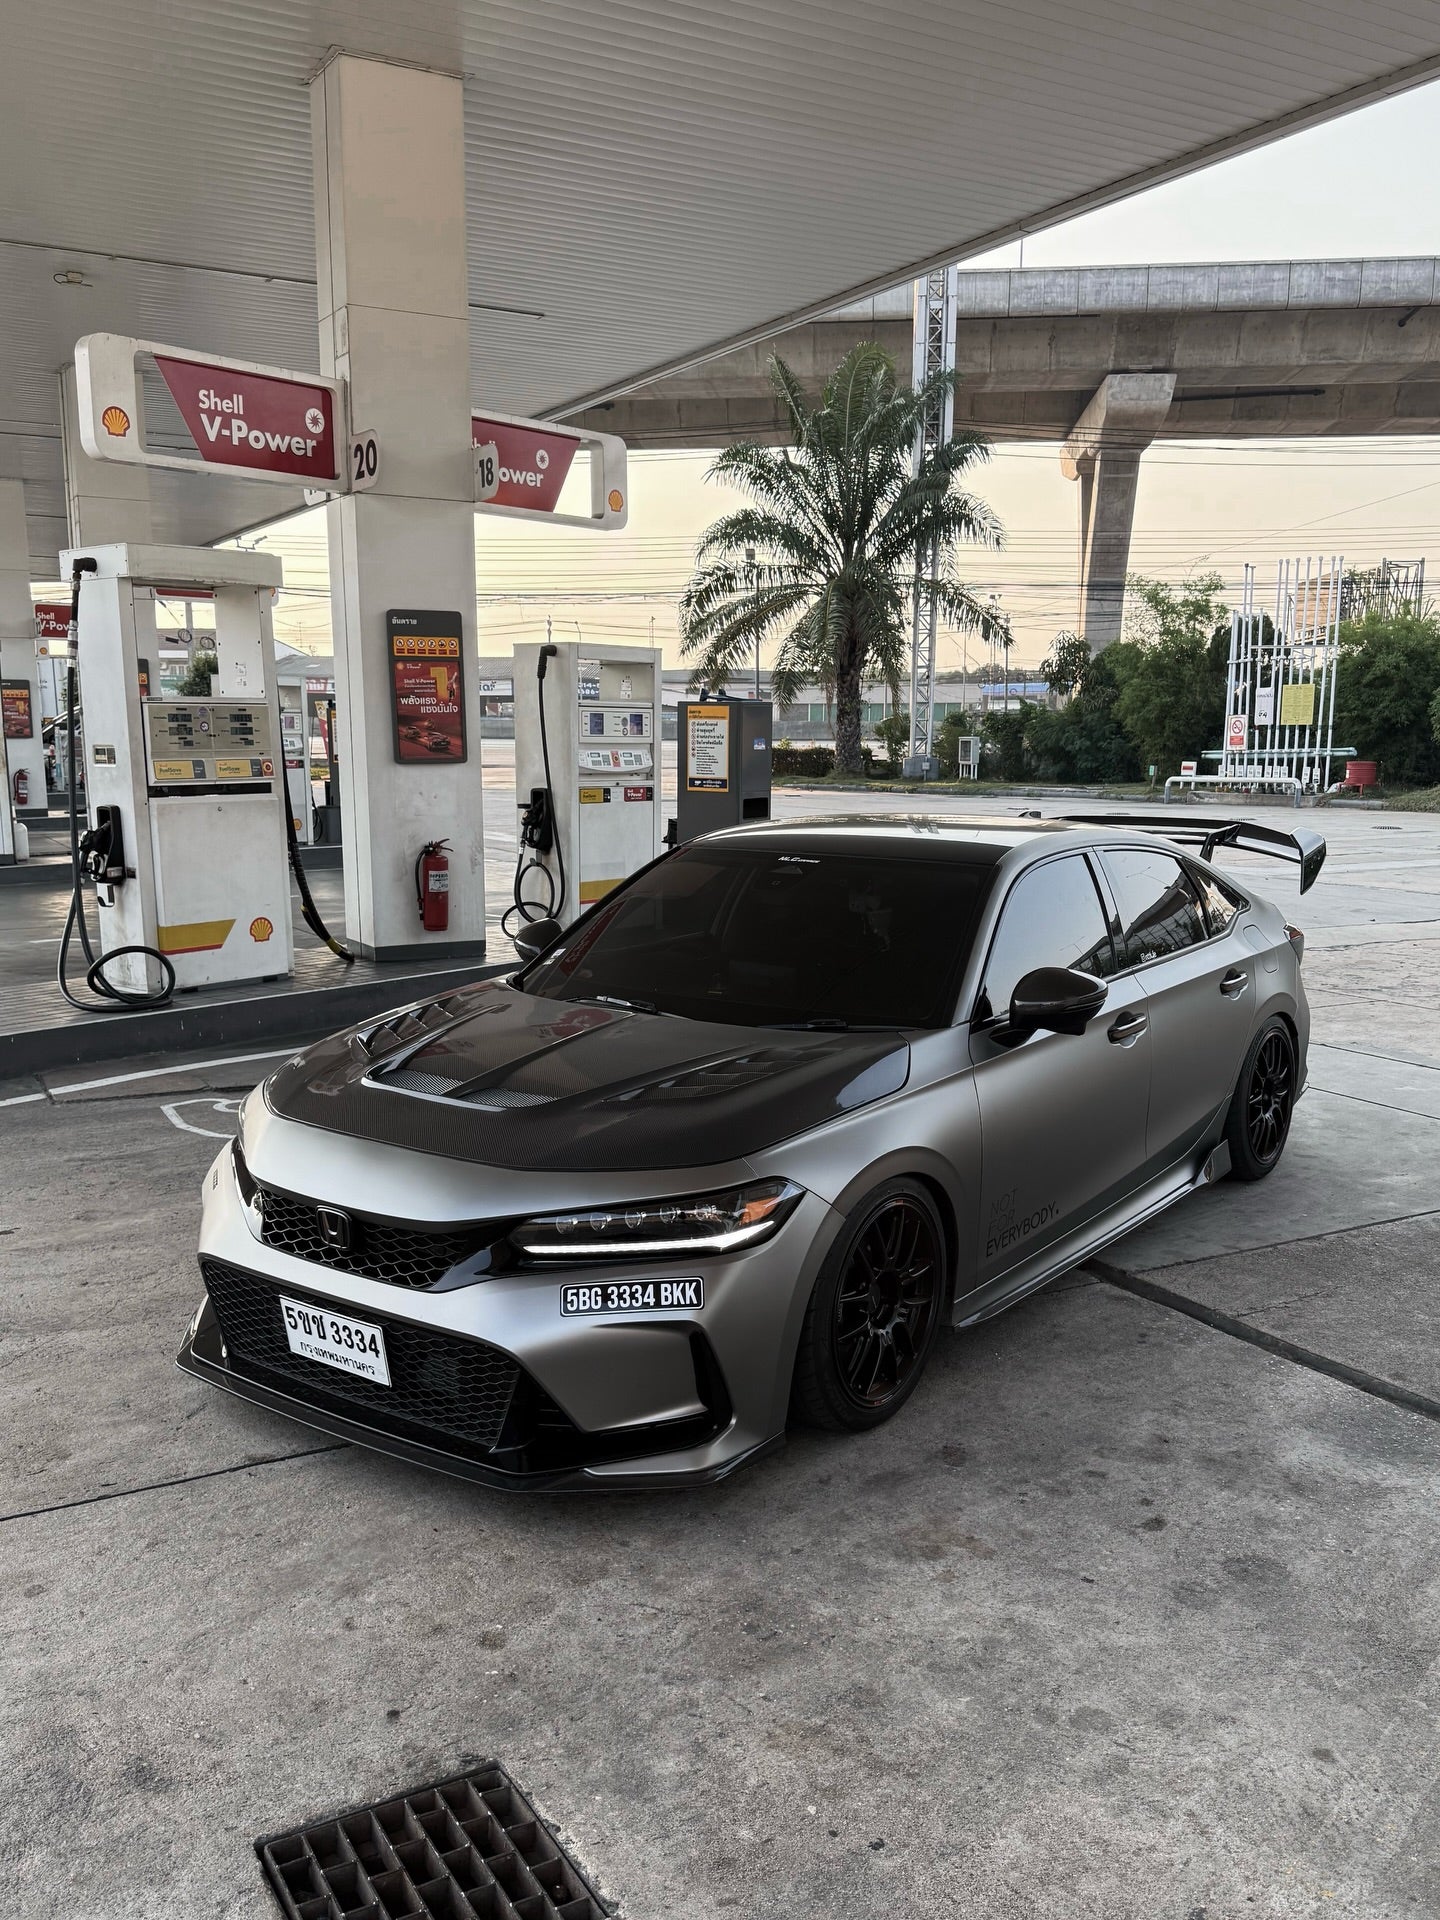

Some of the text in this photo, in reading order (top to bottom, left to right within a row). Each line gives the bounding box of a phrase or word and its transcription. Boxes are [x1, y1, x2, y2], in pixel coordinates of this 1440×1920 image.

[199, 389, 244, 415] Shell
[200, 413, 317, 457] V-Power
[353, 439, 378, 481] 20
[479, 457, 494, 488] 18
[499, 466, 544, 488] ower
[36, 612, 55, 620] Shell
[991, 1187, 1018, 1219] NOT
[985, 1200, 1059, 1258] EVERYBODY.
[566, 1282, 698, 1311] 5BG 3334 BKK
[330, 1321, 380, 1358] 3334
[300, 1341, 375, 1375] กรุงเทพมหานคร
